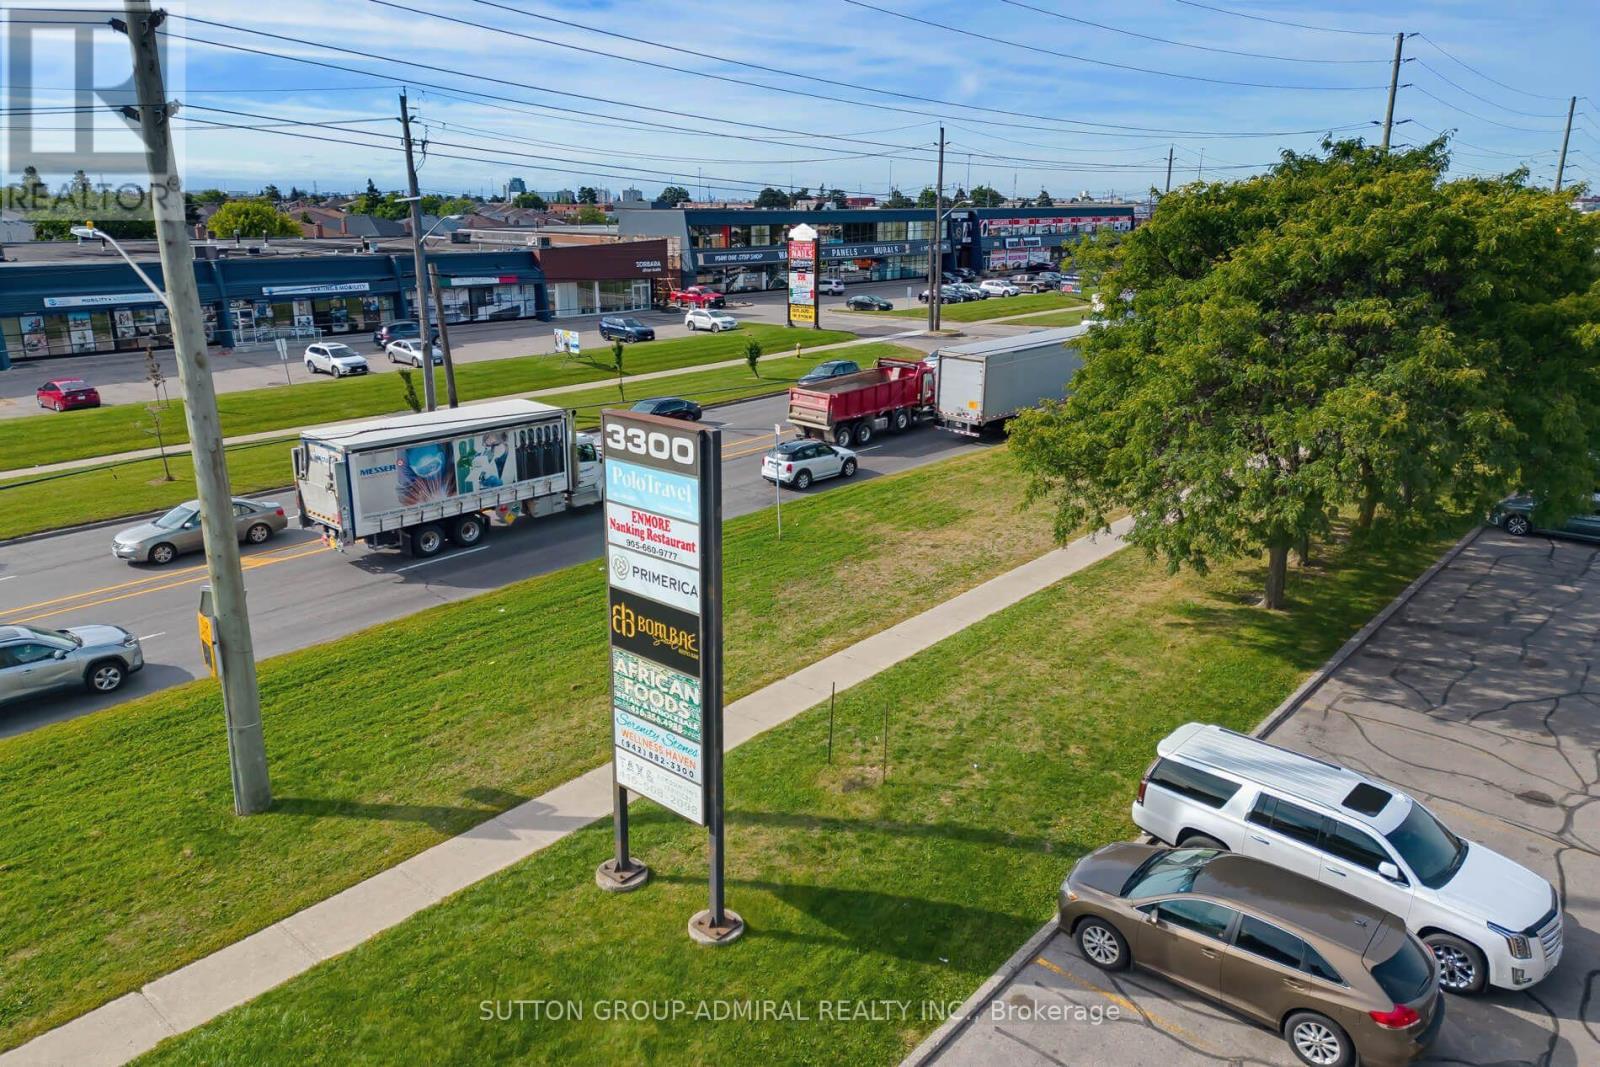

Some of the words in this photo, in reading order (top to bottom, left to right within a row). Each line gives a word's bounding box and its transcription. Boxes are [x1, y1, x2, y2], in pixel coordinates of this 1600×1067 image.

[791, 250, 813, 258] NAILS
[832, 247, 858, 257] PANELS
[874, 245, 899, 255] MURALS
[606, 423, 694, 465] 3300
[360, 464, 397, 477] MESSER
[610, 517, 645, 541] Nanking
[647, 528, 696, 553] Restaurant
[631, 511, 671, 532] ENMORE
[632, 566, 699, 598] PRIMERICA
[638, 615, 698, 652] BOMBAE
[613, 659, 700, 706] AFRICAN
[624, 678, 690, 719] FOODS
[615, 709, 659, 743] Serenity
[621, 727, 663, 755] WELLNESS
[665, 746, 696, 770] HAVEN
